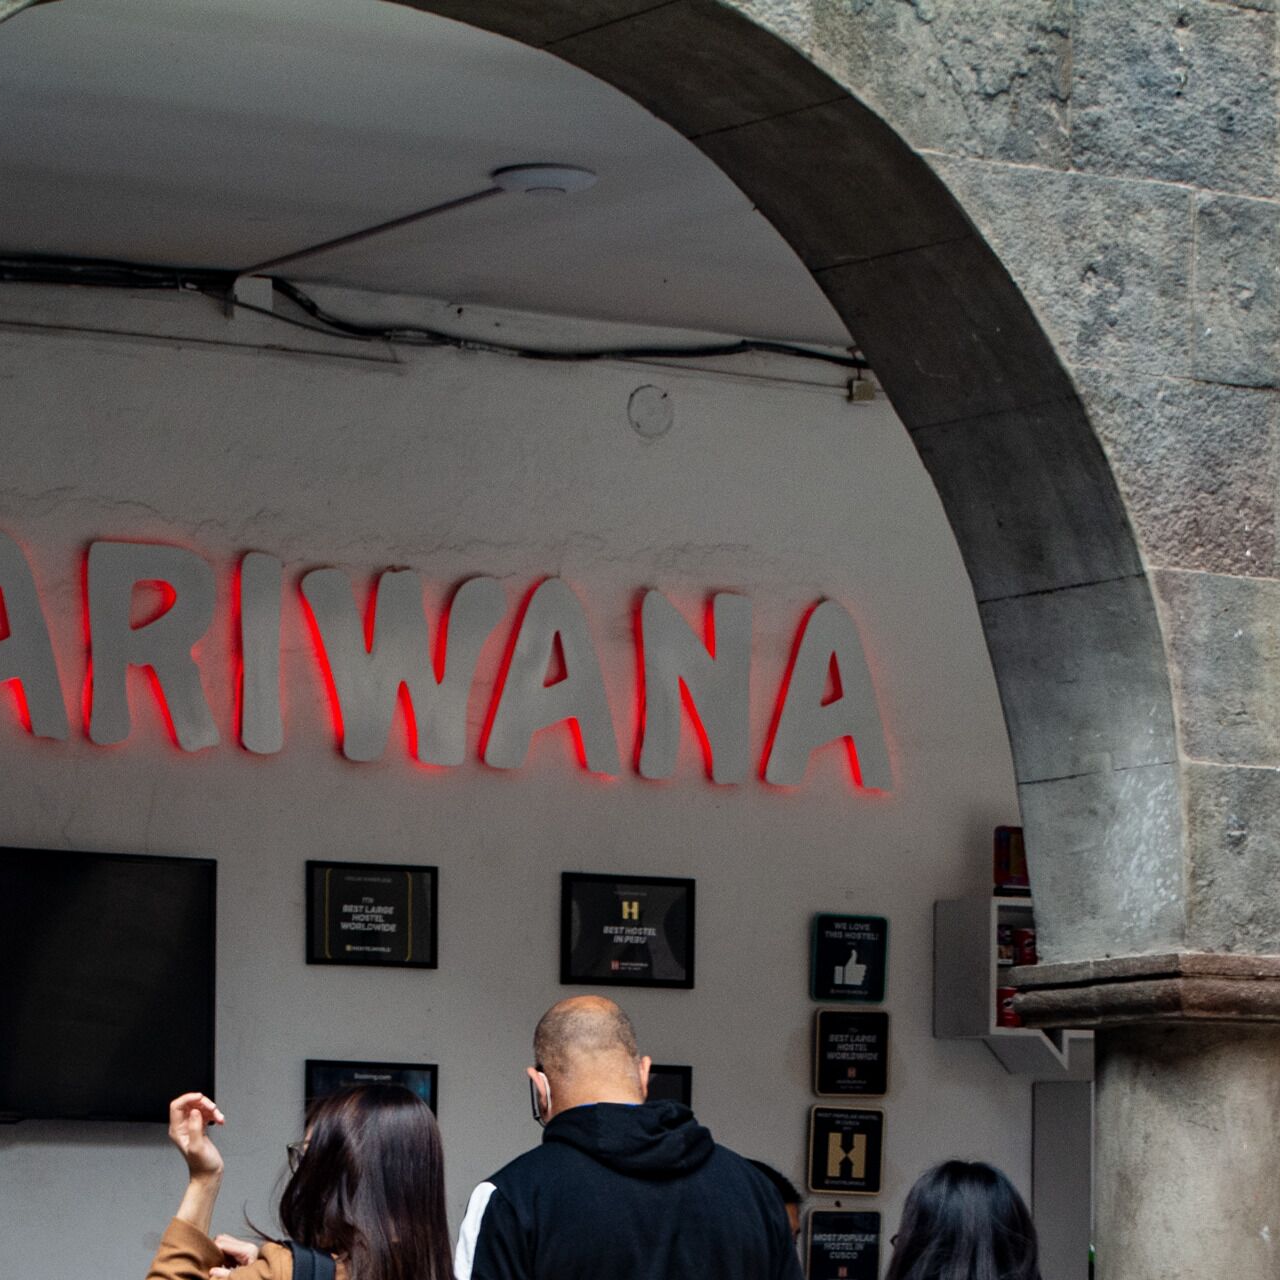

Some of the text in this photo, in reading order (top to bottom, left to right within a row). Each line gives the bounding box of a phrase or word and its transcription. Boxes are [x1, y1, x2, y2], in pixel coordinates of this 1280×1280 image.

[342, 904, 395, 915] BEST LARGE
[351, 914, 385, 923] HOSTEL
[340, 922, 397, 933] WORLDWIDE
[603, 926, 656, 936] BEST HOSTEL
[833, 922, 871, 931] WE LOVE
[824, 930, 843, 939] THIS
[624, 936, 647, 945] PERU
